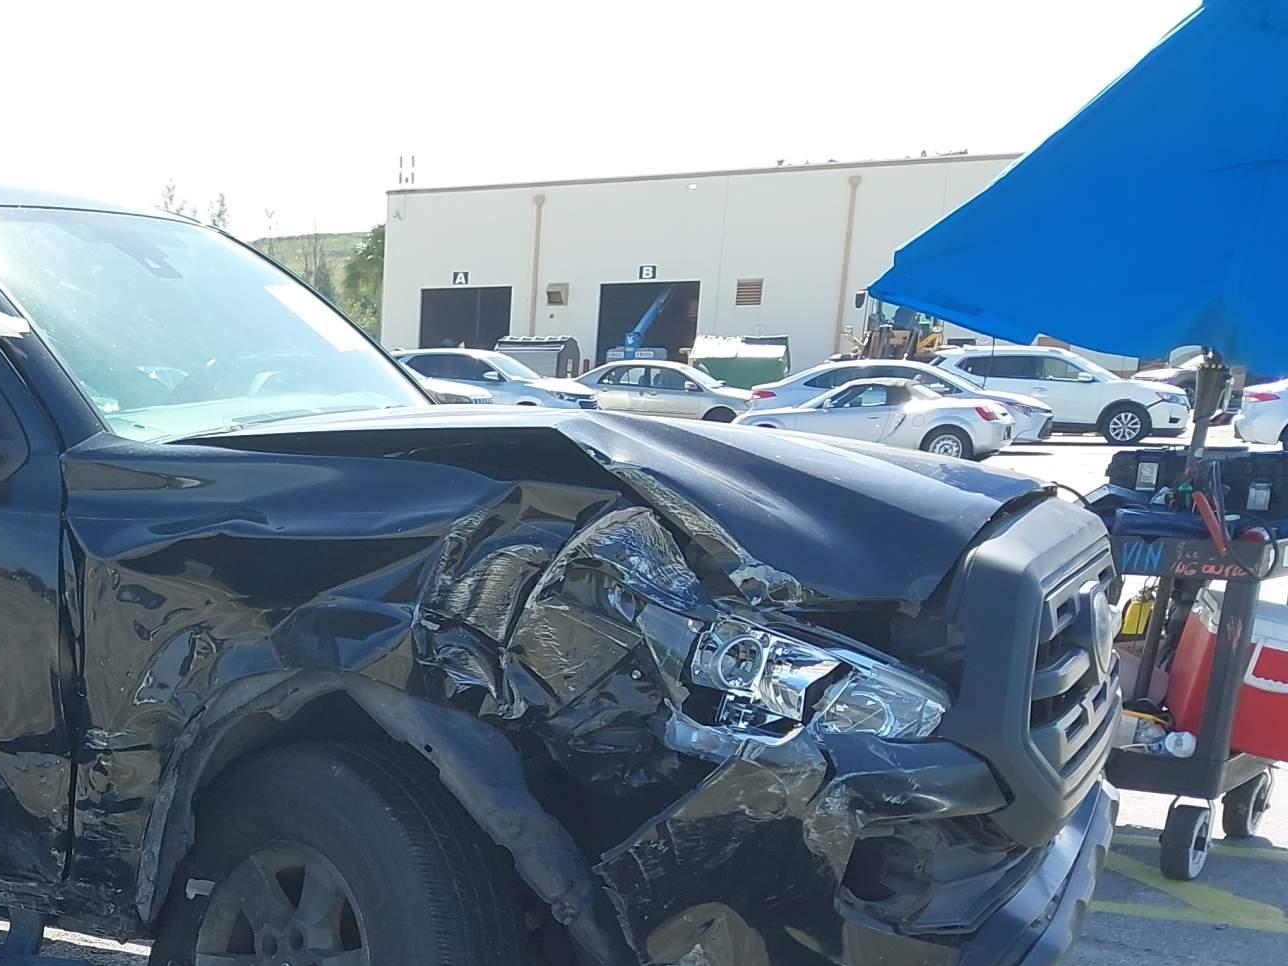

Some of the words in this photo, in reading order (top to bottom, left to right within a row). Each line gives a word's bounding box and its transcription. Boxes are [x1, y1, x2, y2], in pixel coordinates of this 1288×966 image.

[642, 267, 653, 278] B
[455, 273, 466, 284] A
[1120, 542, 1164, 571] VIN
